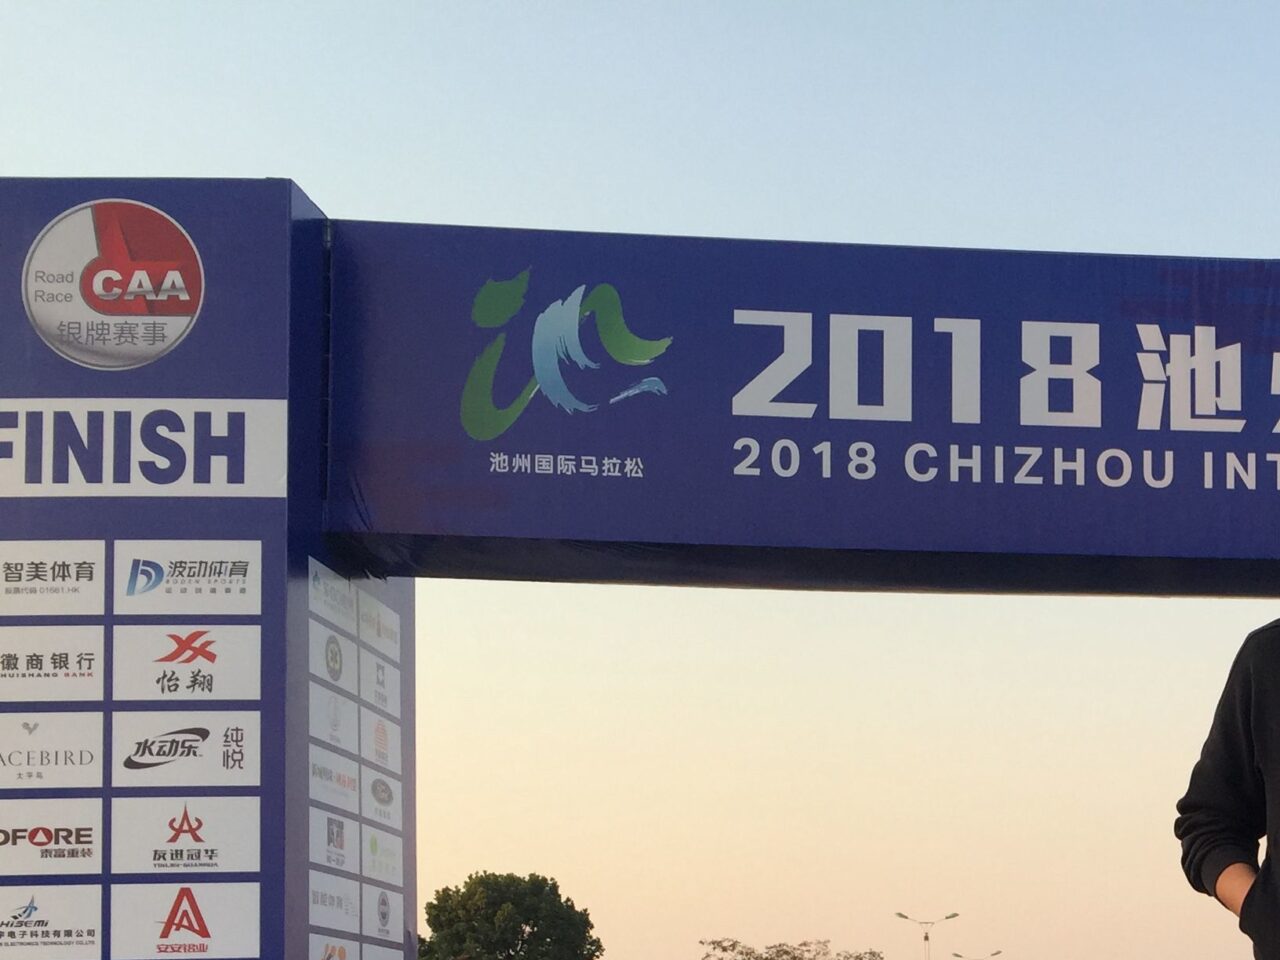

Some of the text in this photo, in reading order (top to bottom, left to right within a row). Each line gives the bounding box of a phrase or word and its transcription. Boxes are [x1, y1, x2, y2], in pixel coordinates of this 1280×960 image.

[34, 271, 75, 283] Road
[92, 270, 190, 300] CAA
[34, 290, 73, 303] Race
[57, 321, 168, 347] 银牌赛事
[490, 452, 644, 478] 池州国际马拉松
[733, 437, 877, 480] 2018
[904, 442, 1175, 489] CHIZHOU
[2, 560, 96, 583] 智美体育
[166, 560, 249, 578] 波动体育
[0, 652, 95, 671] 徽商银行
[156, 669, 214, 694] 怡翔
[133, 739, 200, 758] 水动乐
[222, 727, 244, 770] 纯悦
